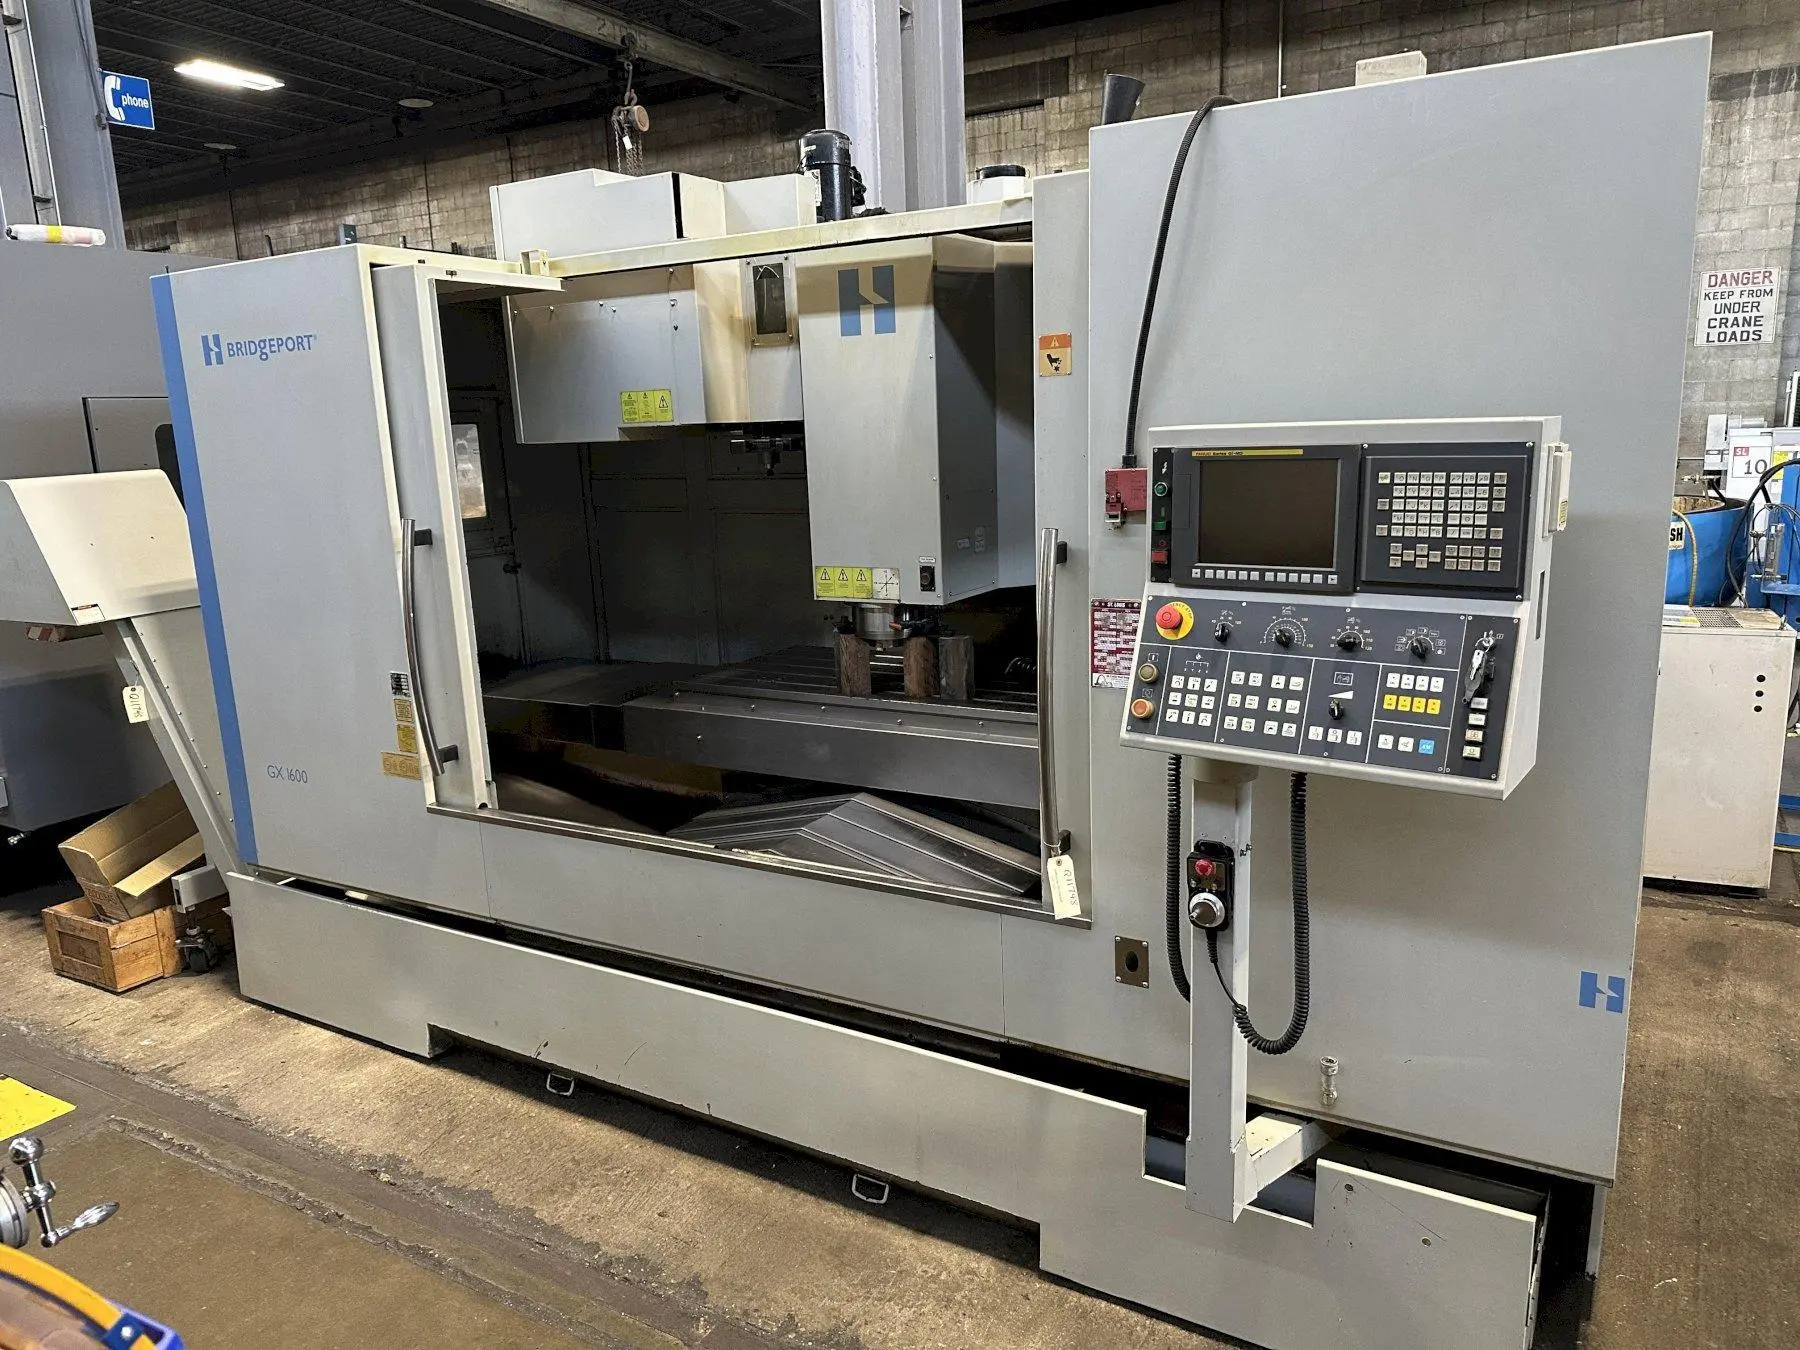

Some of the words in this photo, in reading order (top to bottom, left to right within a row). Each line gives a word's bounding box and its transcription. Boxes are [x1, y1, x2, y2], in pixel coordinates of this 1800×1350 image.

[121, 92, 149, 109] phone
[1708, 270, 1773, 288] DANGER
[1703, 290, 1735, 301] KEEP
[1739, 288, 1773, 299] FROM
[1714, 301, 1761, 314] UNDER
[1707, 315, 1764, 329] CRANE
[1705, 330, 1763, 343] LOADS
[1735, 447, 1749, 456] SL
[1744, 459, 1767, 475] 10
[267, 764, 285, 781] GX
[286, 767, 308, 784] 1600
